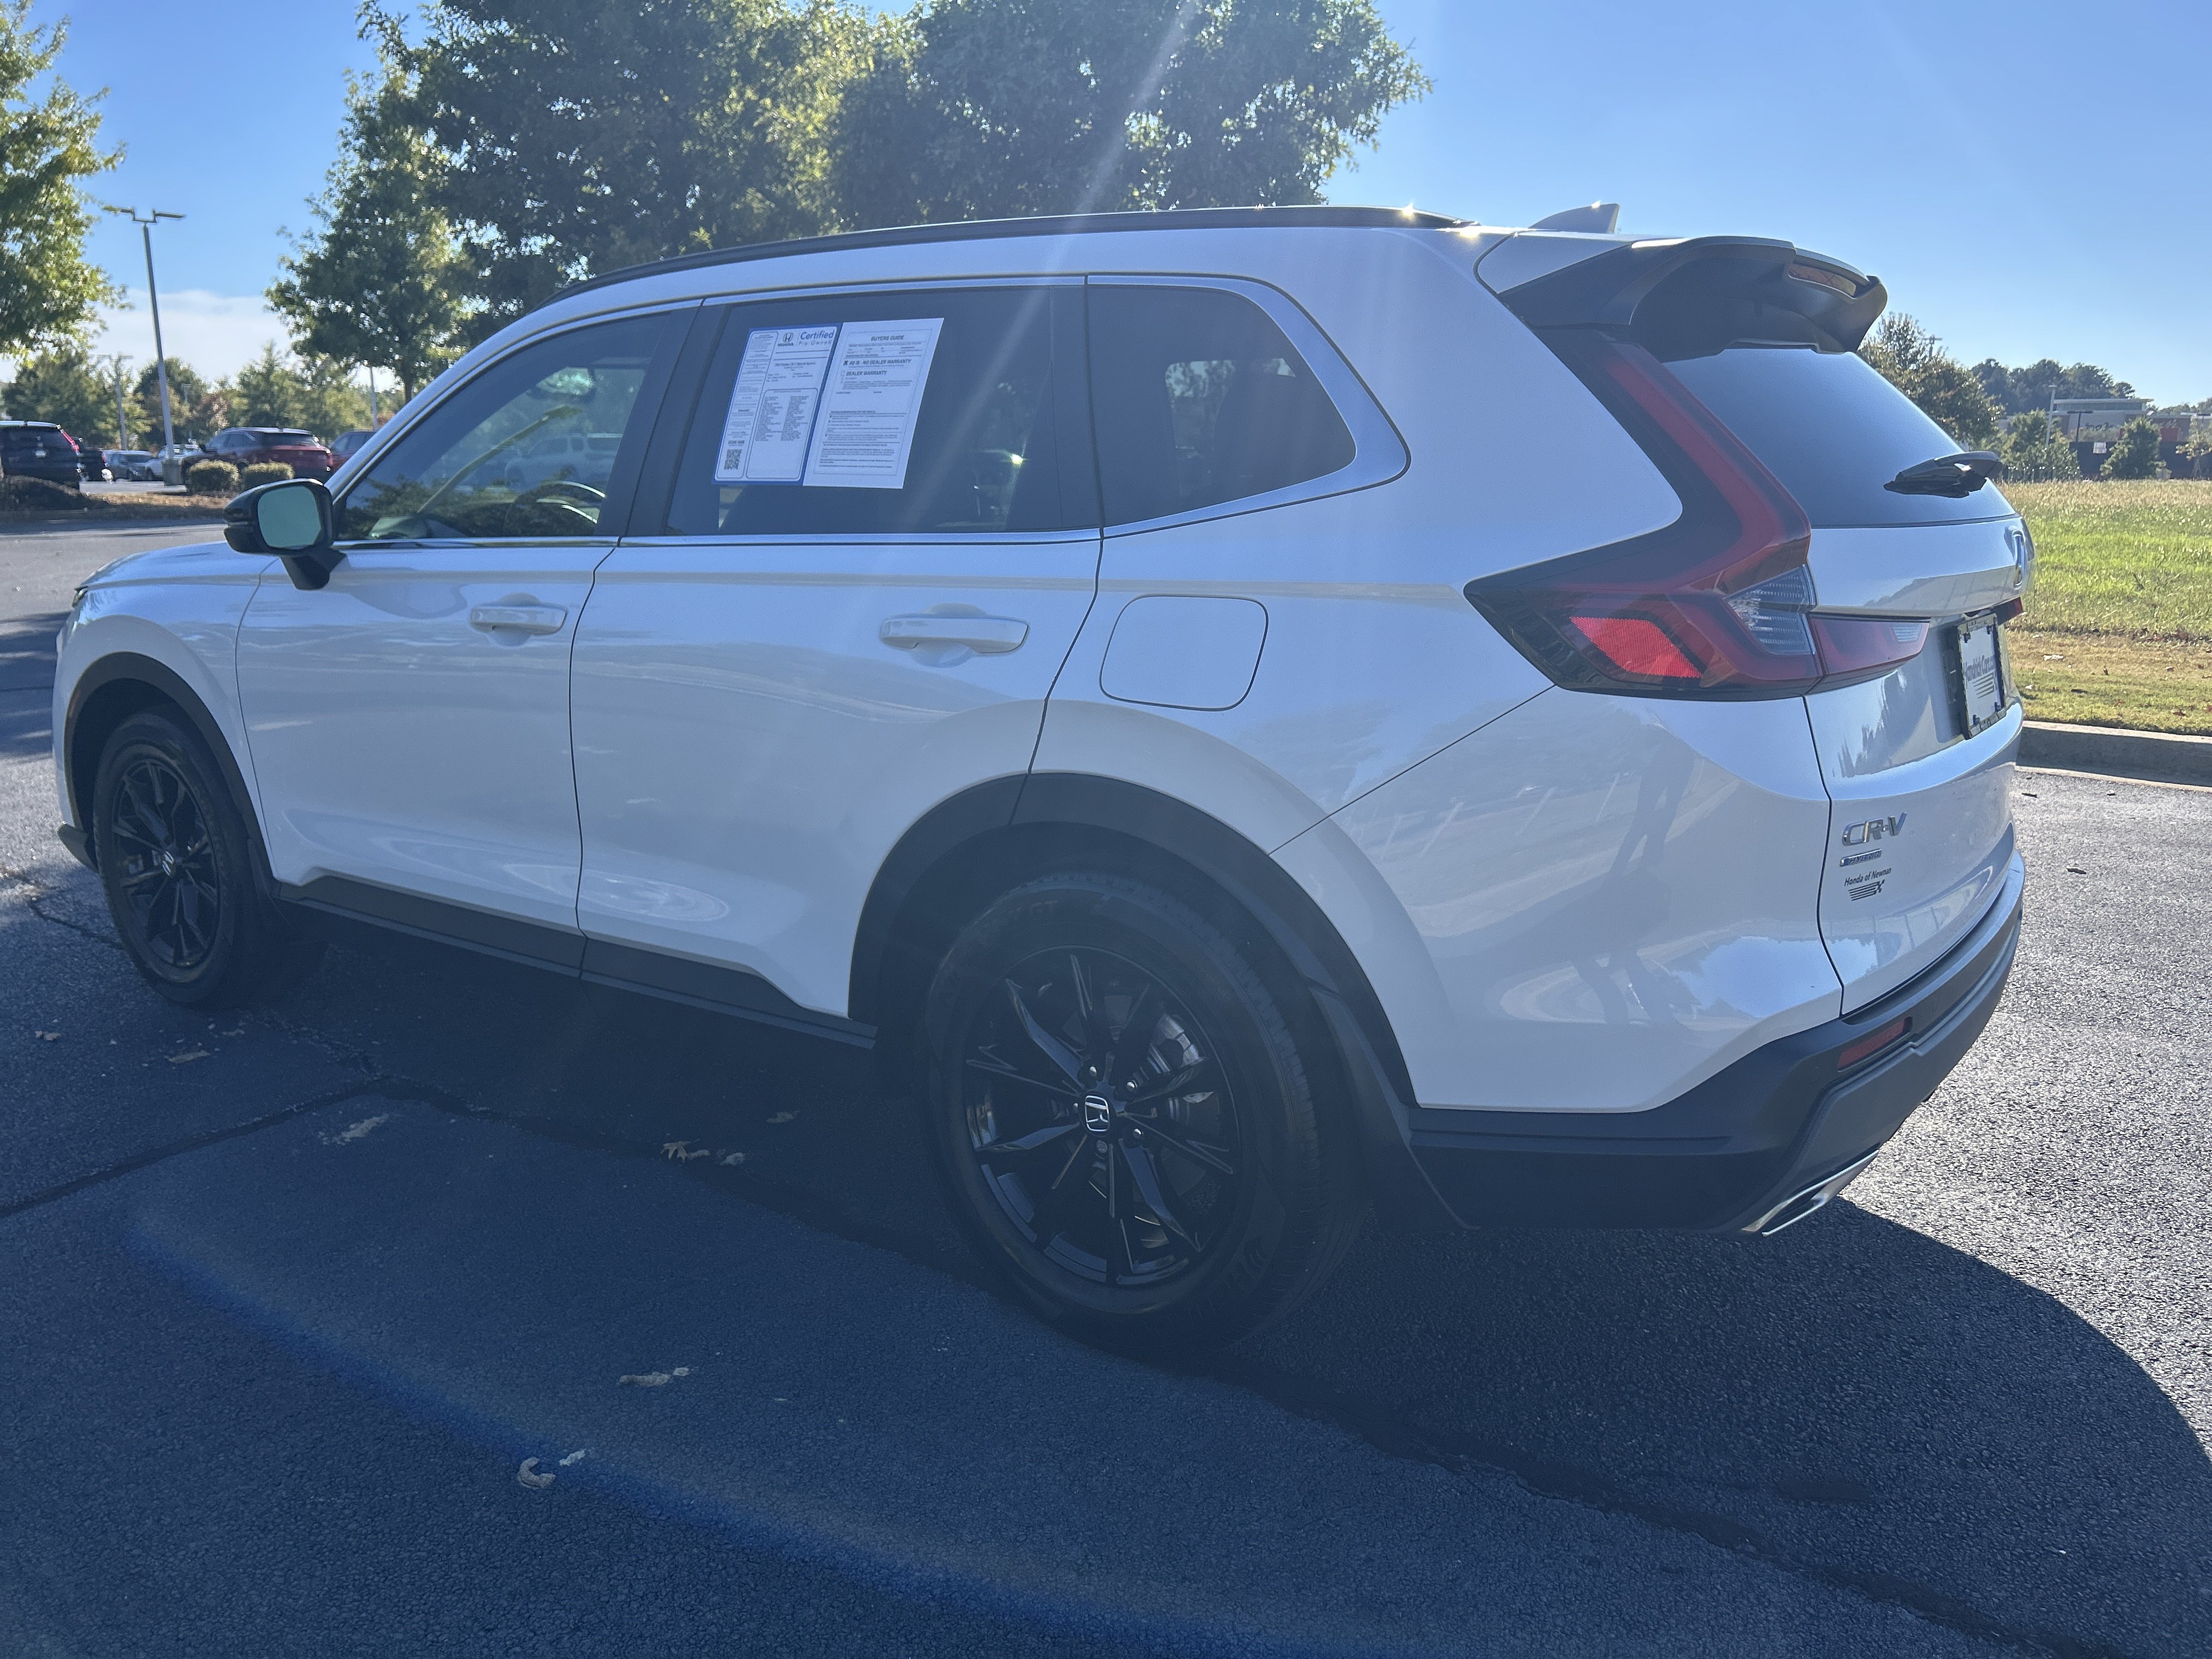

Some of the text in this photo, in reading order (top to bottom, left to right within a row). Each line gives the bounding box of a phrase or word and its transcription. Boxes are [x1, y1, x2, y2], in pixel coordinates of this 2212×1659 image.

[800, 330, 834, 340] Certified
[1842, 812, 1907, 846] CR-V
[1849, 851, 1880, 865] HYBRID
[1844, 874, 1864, 887] Honda
[1864, 871, 1872, 881] of
